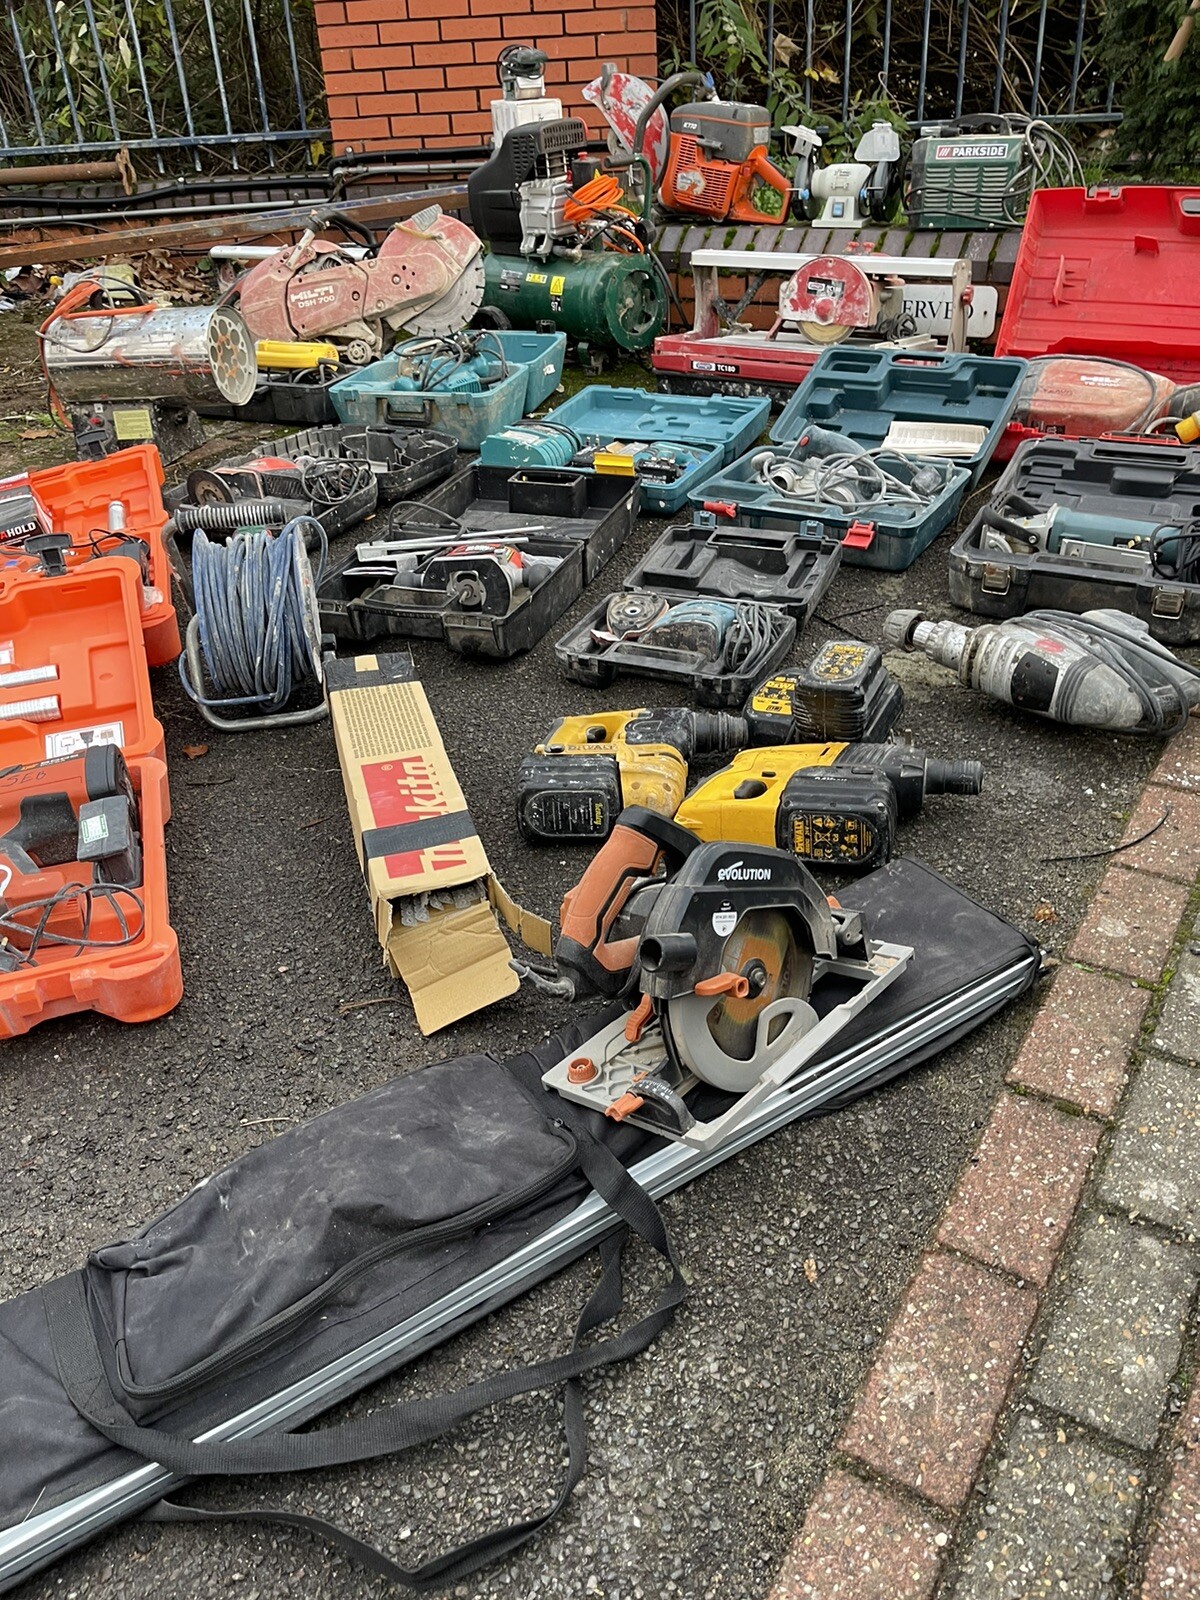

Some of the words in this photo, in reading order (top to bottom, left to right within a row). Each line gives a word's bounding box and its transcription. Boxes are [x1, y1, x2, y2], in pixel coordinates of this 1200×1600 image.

[952, 146, 1004, 157] PARKSIDE
[290, 285, 334, 302] HILTI
[298, 299, 317, 308] DSH
[318, 295, 335, 304] 700
[717, 364, 736, 373] TC180
